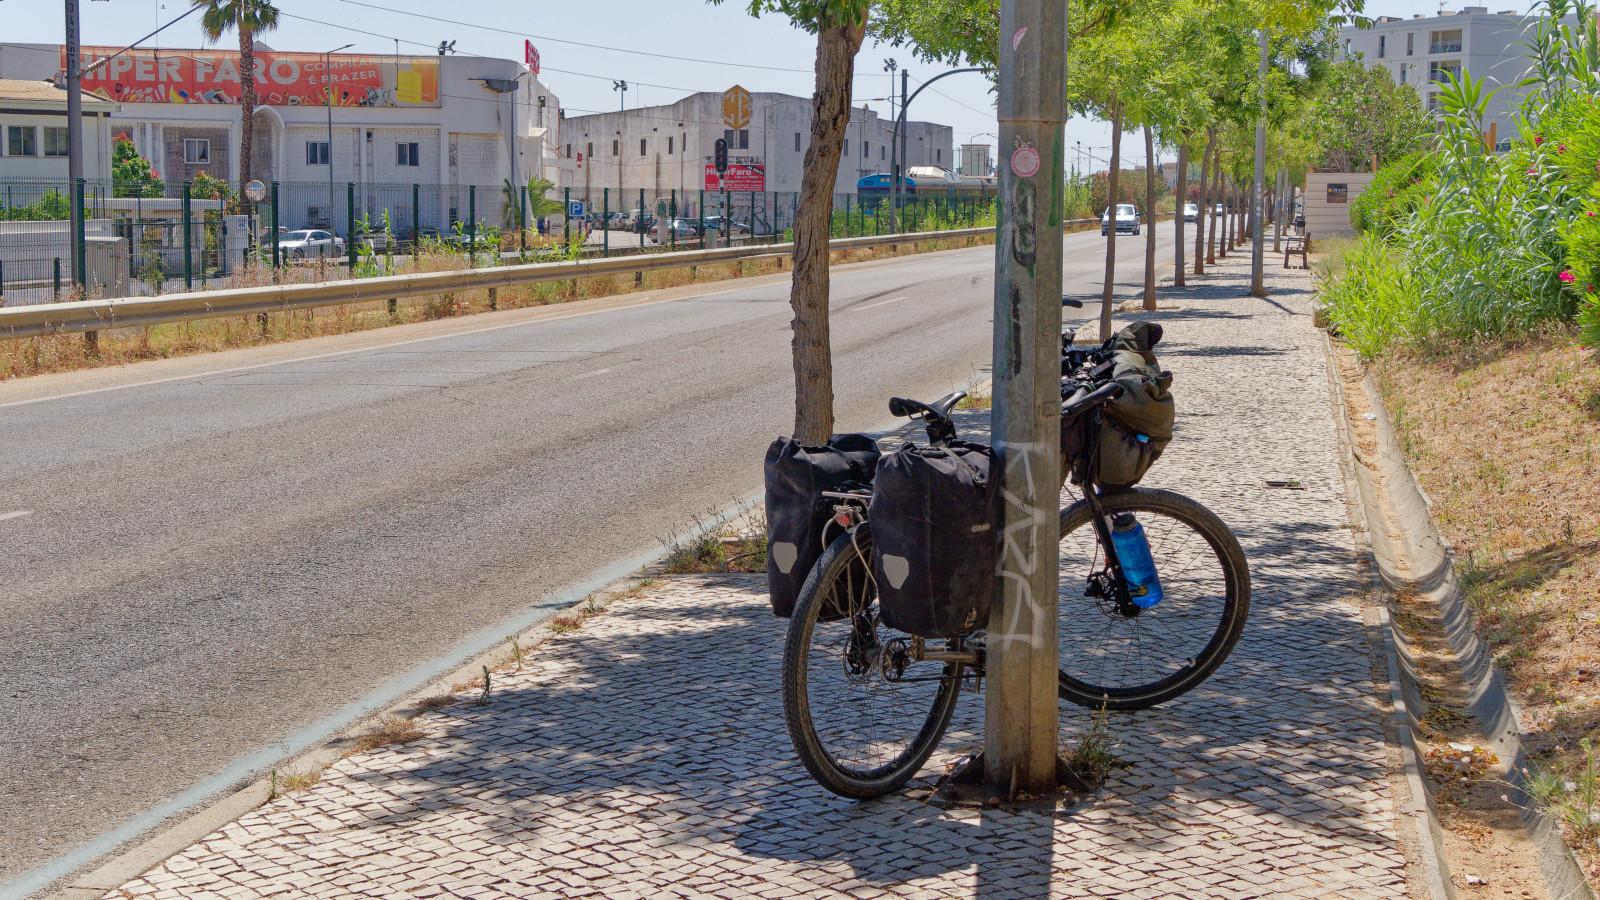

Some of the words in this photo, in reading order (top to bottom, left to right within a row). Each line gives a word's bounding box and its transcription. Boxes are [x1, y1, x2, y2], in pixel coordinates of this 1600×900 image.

[196, 55, 300, 85] FARO
[308, 75, 317, 85] É
[321, 70, 377, 83] PRAZER
[572, 204, 581, 214] P
